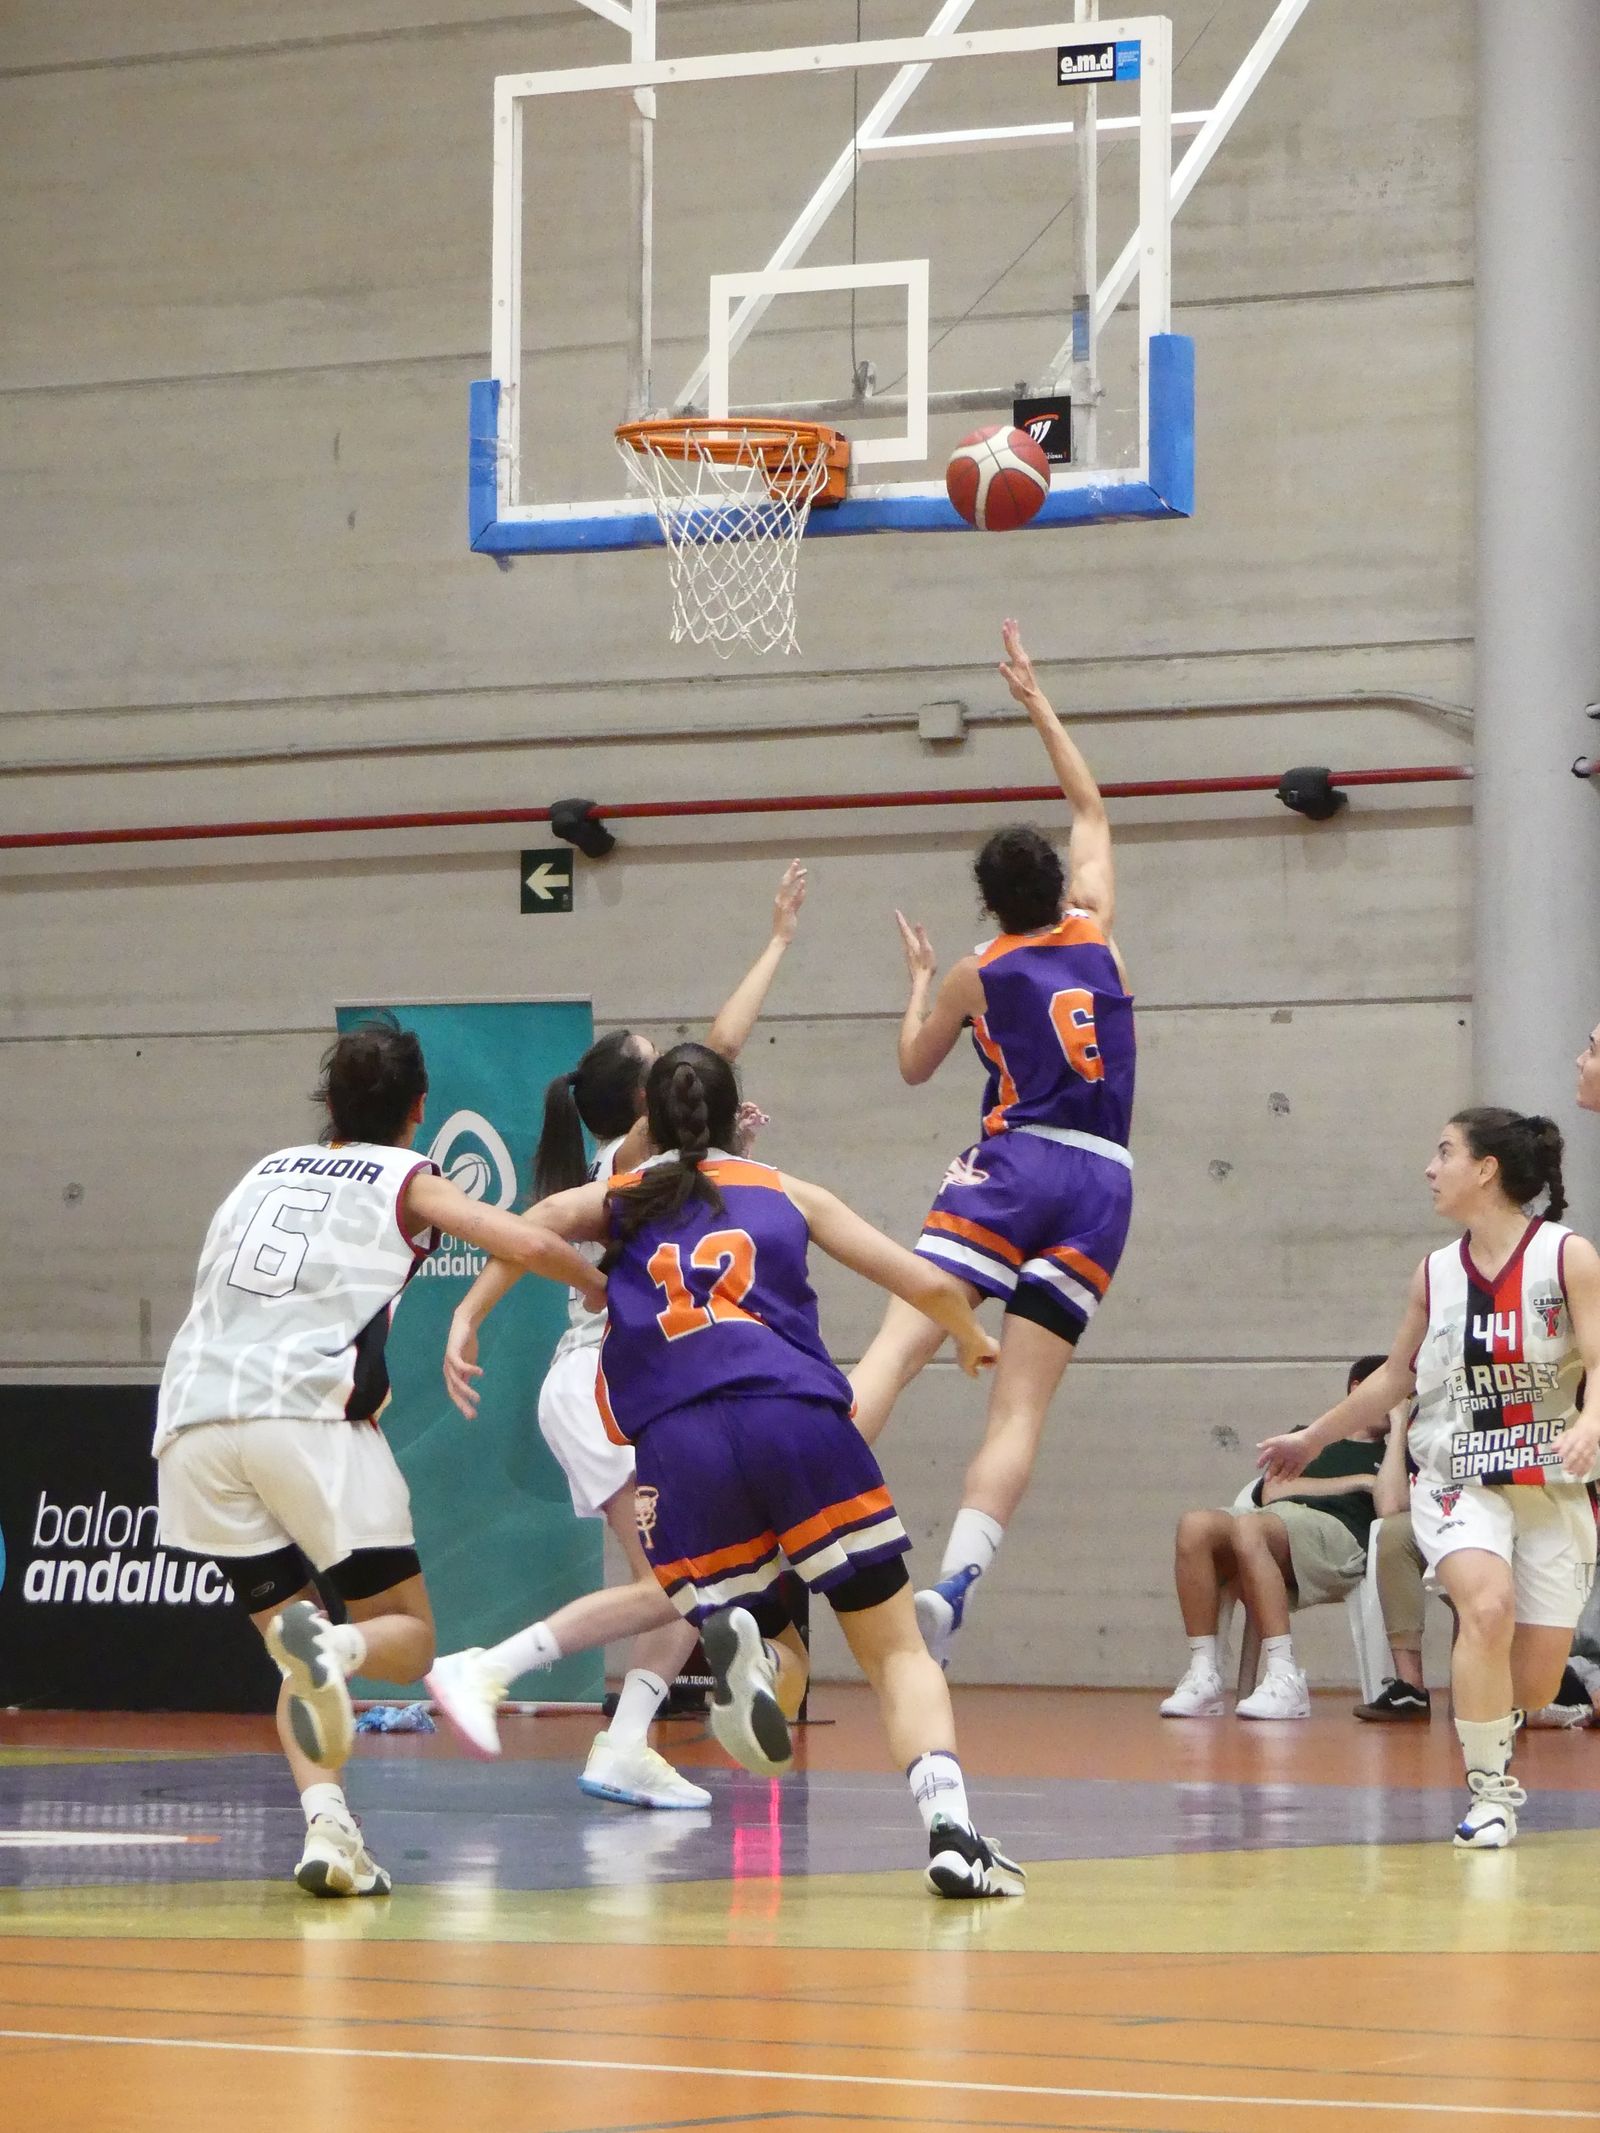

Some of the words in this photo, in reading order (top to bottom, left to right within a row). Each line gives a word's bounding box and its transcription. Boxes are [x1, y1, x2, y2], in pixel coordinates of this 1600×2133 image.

[1061, 47, 1113, 73] e.m.d
[1049, 987, 1104, 1083] 6
[258, 1158, 384, 1185] CLAUDIA
[227, 1185, 331, 1298] 6
[416, 1253, 488, 1276] ndalu
[646, 1228, 766, 1342] 12
[1473, 1311, 1516, 1352] 44
[1461, 1394, 1499, 1413] FORT
[1501, 1389, 1543, 1407] PIENC
[1453, 1420, 1566, 1455] CAMPING
